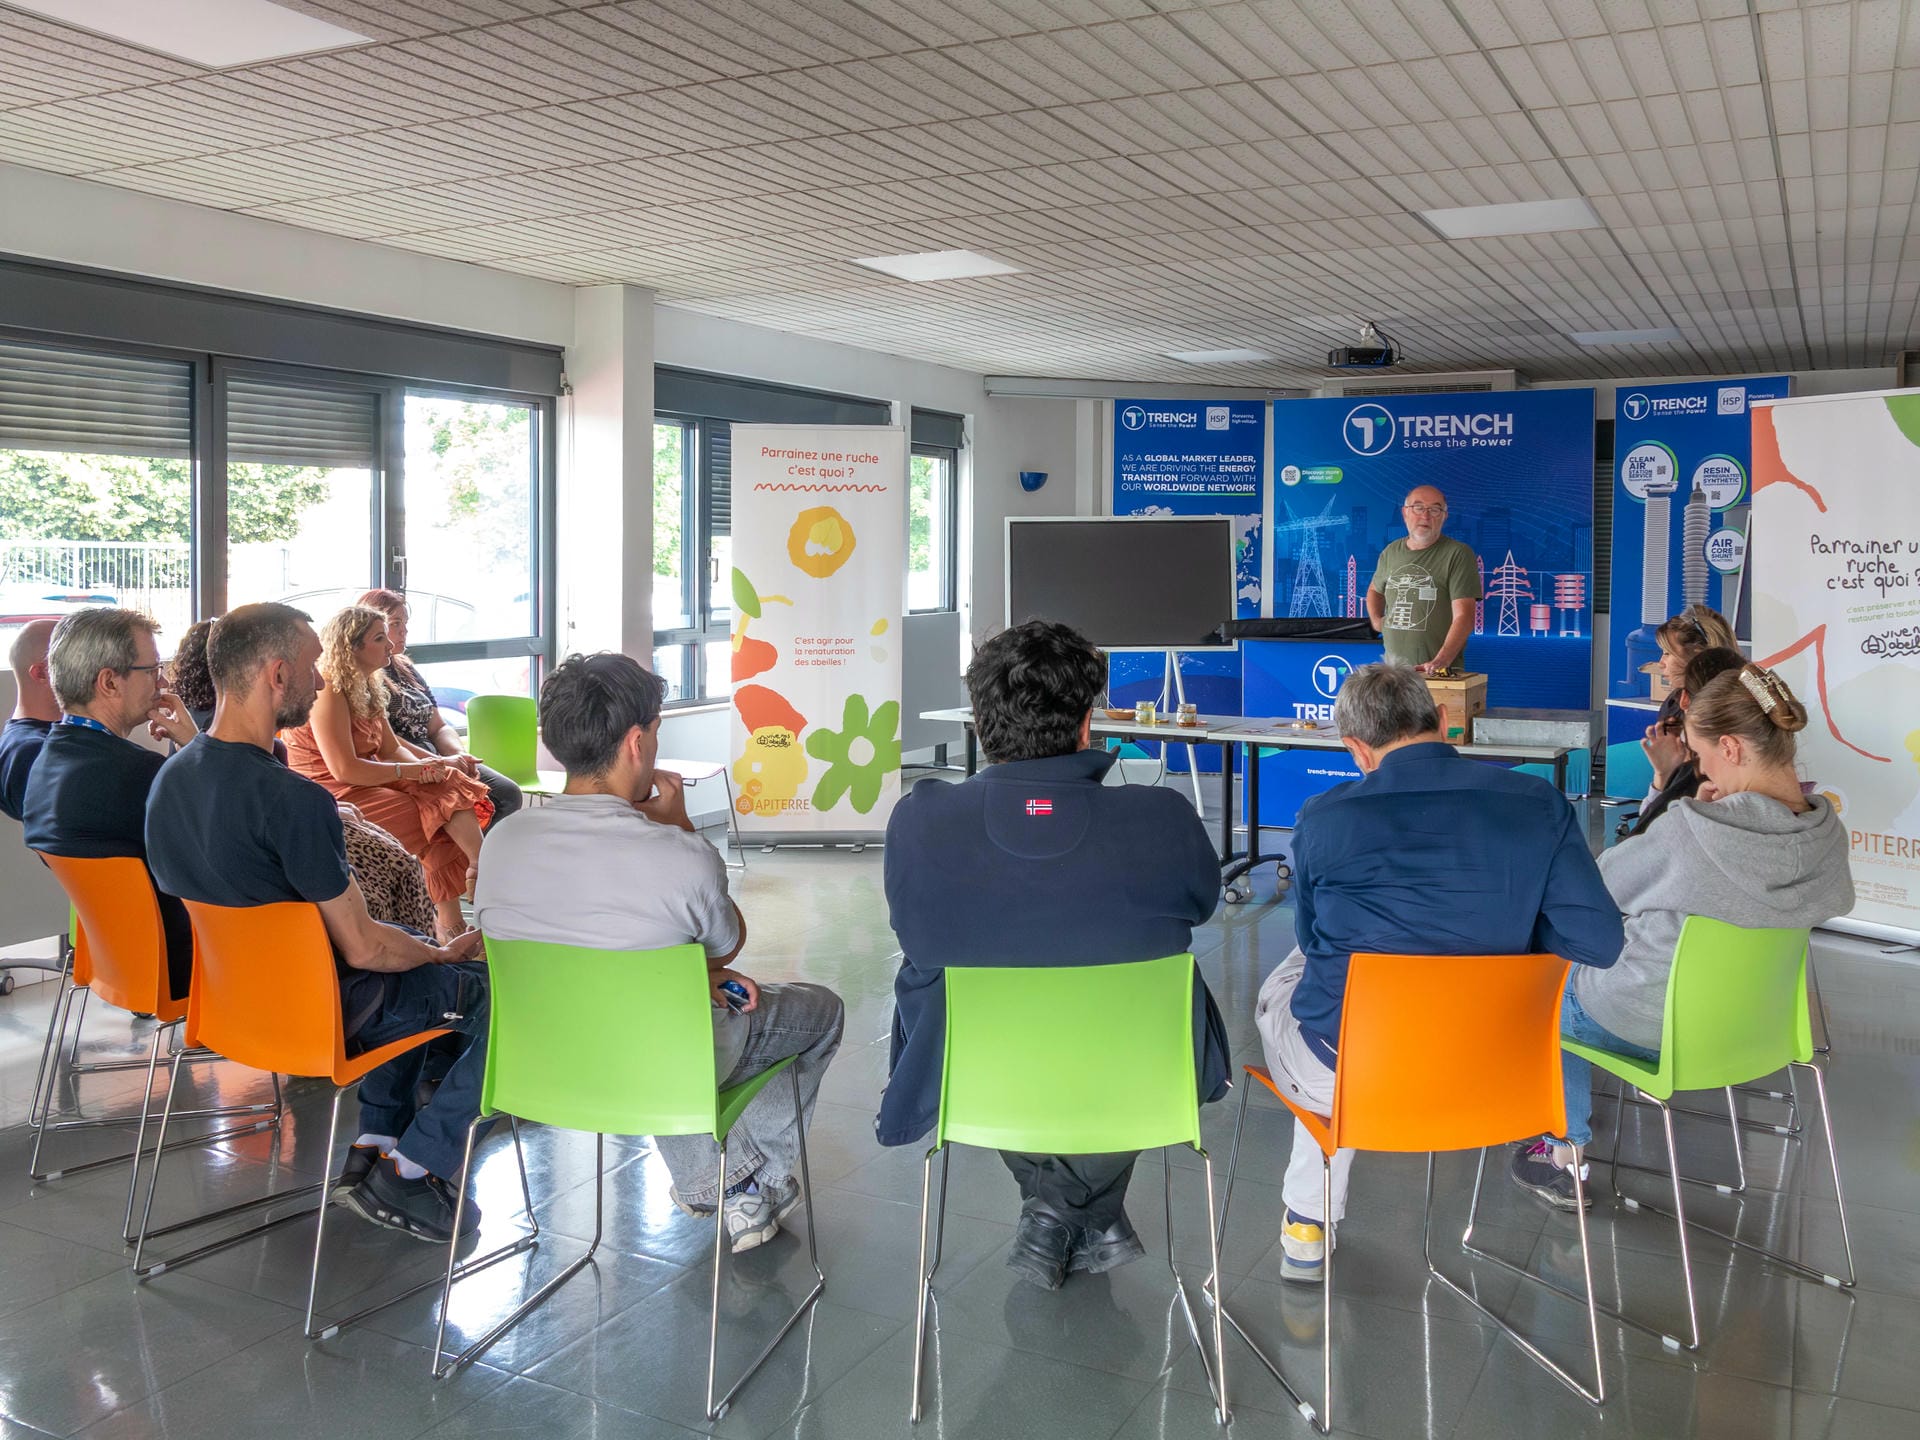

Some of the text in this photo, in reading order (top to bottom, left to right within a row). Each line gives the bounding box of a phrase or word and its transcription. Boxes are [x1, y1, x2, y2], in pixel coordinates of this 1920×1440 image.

[1651, 396, 1707, 411] TRENCH
[1722, 396, 1741, 406] HSP
[1686, 407, 1707, 415] Power
[1147, 412, 1197, 423] TRENCH
[1210, 415, 1226, 423] HSP
[1398, 413, 1513, 437] TRENCH
[1403, 437, 1513, 449] Sense the Power
[761, 447, 879, 464] Parrainez une ruche
[1122, 454, 1257, 464] AS A GLOBAL MARKET LEADER,
[1122, 463, 1256, 473] WE ARE DRIVING THE ENERGY
[1629, 462, 1646, 470] AIR
[788, 465, 855, 479] c'est quoi ?
[1122, 473, 1256, 483] TRANSITION FORWARD WITH
[1121, 482, 1256, 492] OUR WORLDWIDE NETWORK
[1711, 538, 1733, 548] AIR
[1810, 534, 1903, 554] Parrainer
[1846, 554, 1900, 573] ruche
[1826, 573, 1865, 590] c'est
[1873, 572, 1910, 599] quoi
[1881, 627, 1913, 639] vive
[816, 637, 833, 646] agir
[835, 638, 854, 646] pour
[804, 647, 855, 655] renaturation
[794, 658, 809, 666] des
[811, 658, 842, 666] abeilles
[1307, 768, 1361, 778] trench-group.com
[755, 799, 810, 811] APITERRE
[1851, 830, 1920, 859] PITERR
